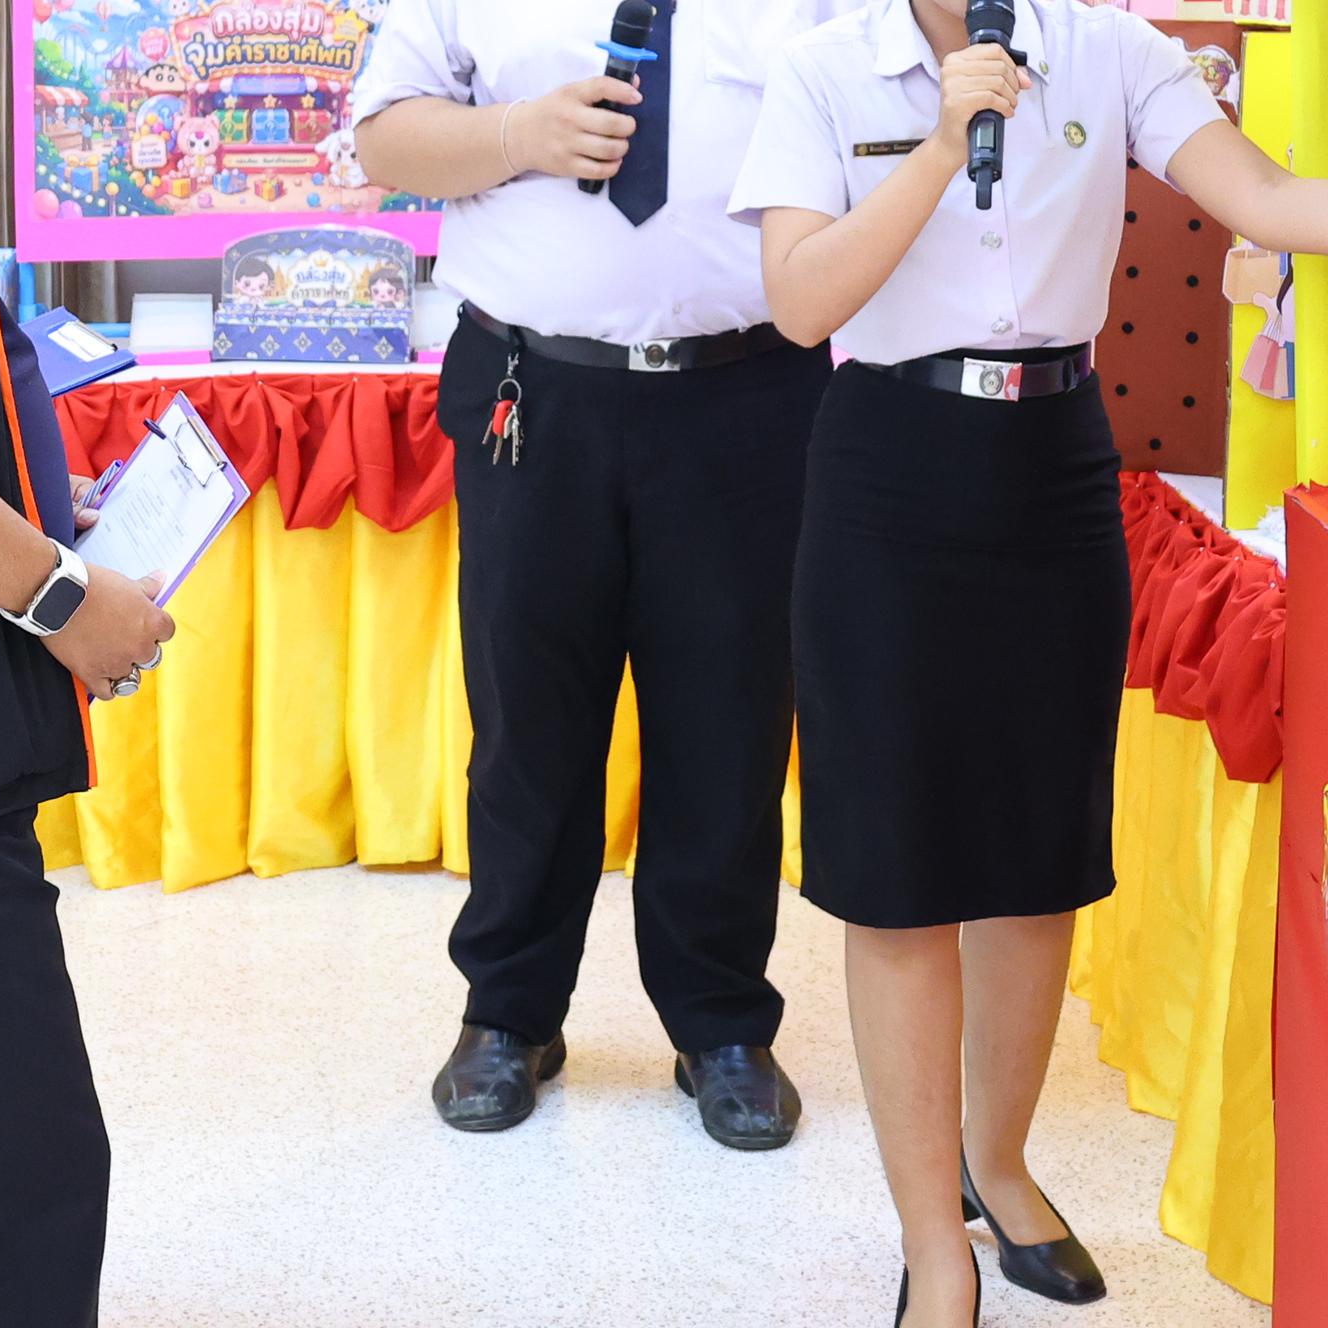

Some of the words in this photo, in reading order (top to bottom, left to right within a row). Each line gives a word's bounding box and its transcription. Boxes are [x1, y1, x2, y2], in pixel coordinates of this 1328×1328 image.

[213, 1, 323, 42] กล่องสุ่ม
[185, 32, 356, 80] จุ่มคำราชาศัพท์
